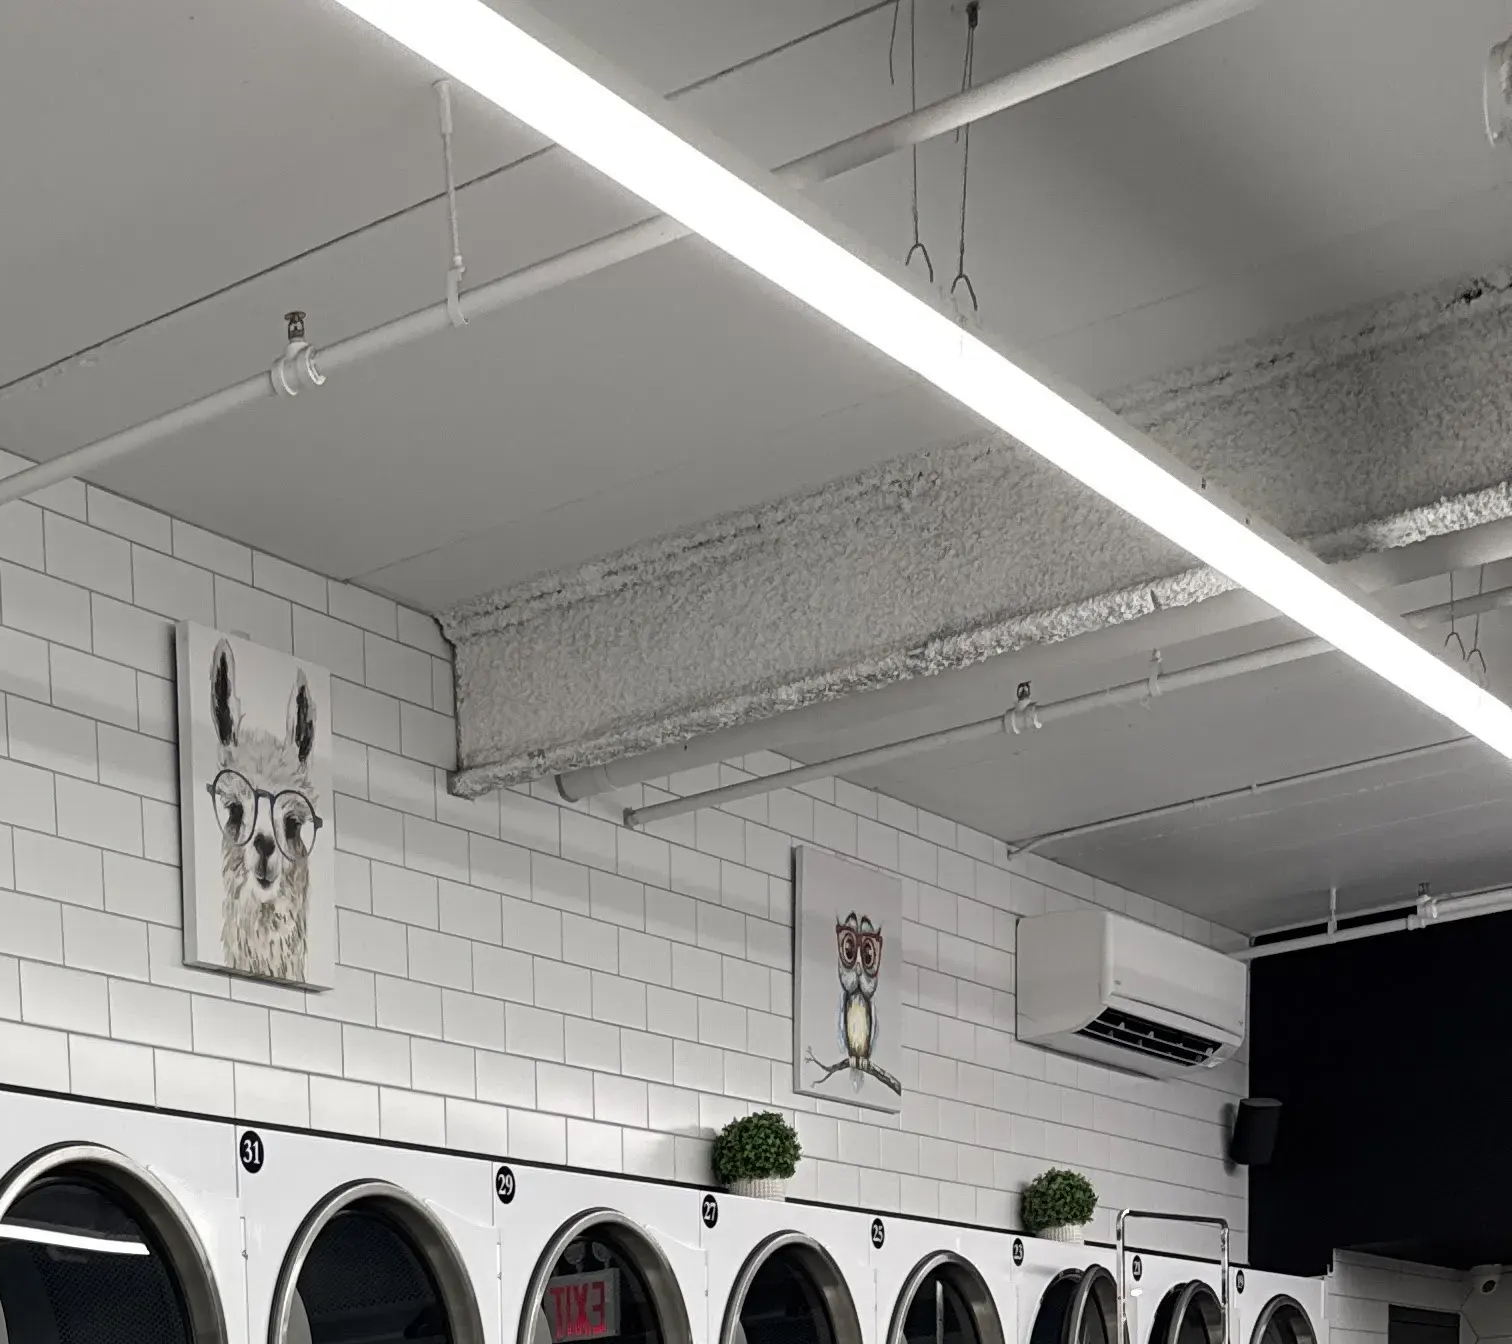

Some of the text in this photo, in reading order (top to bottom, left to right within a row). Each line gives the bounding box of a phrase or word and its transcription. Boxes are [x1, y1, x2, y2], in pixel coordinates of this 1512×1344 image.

[243, 1139, 260, 1164] 31
[498, 1174, 513, 1196] 29
[704, 1201, 716, 1221] 27
[873, 1224, 883, 1242] 25
